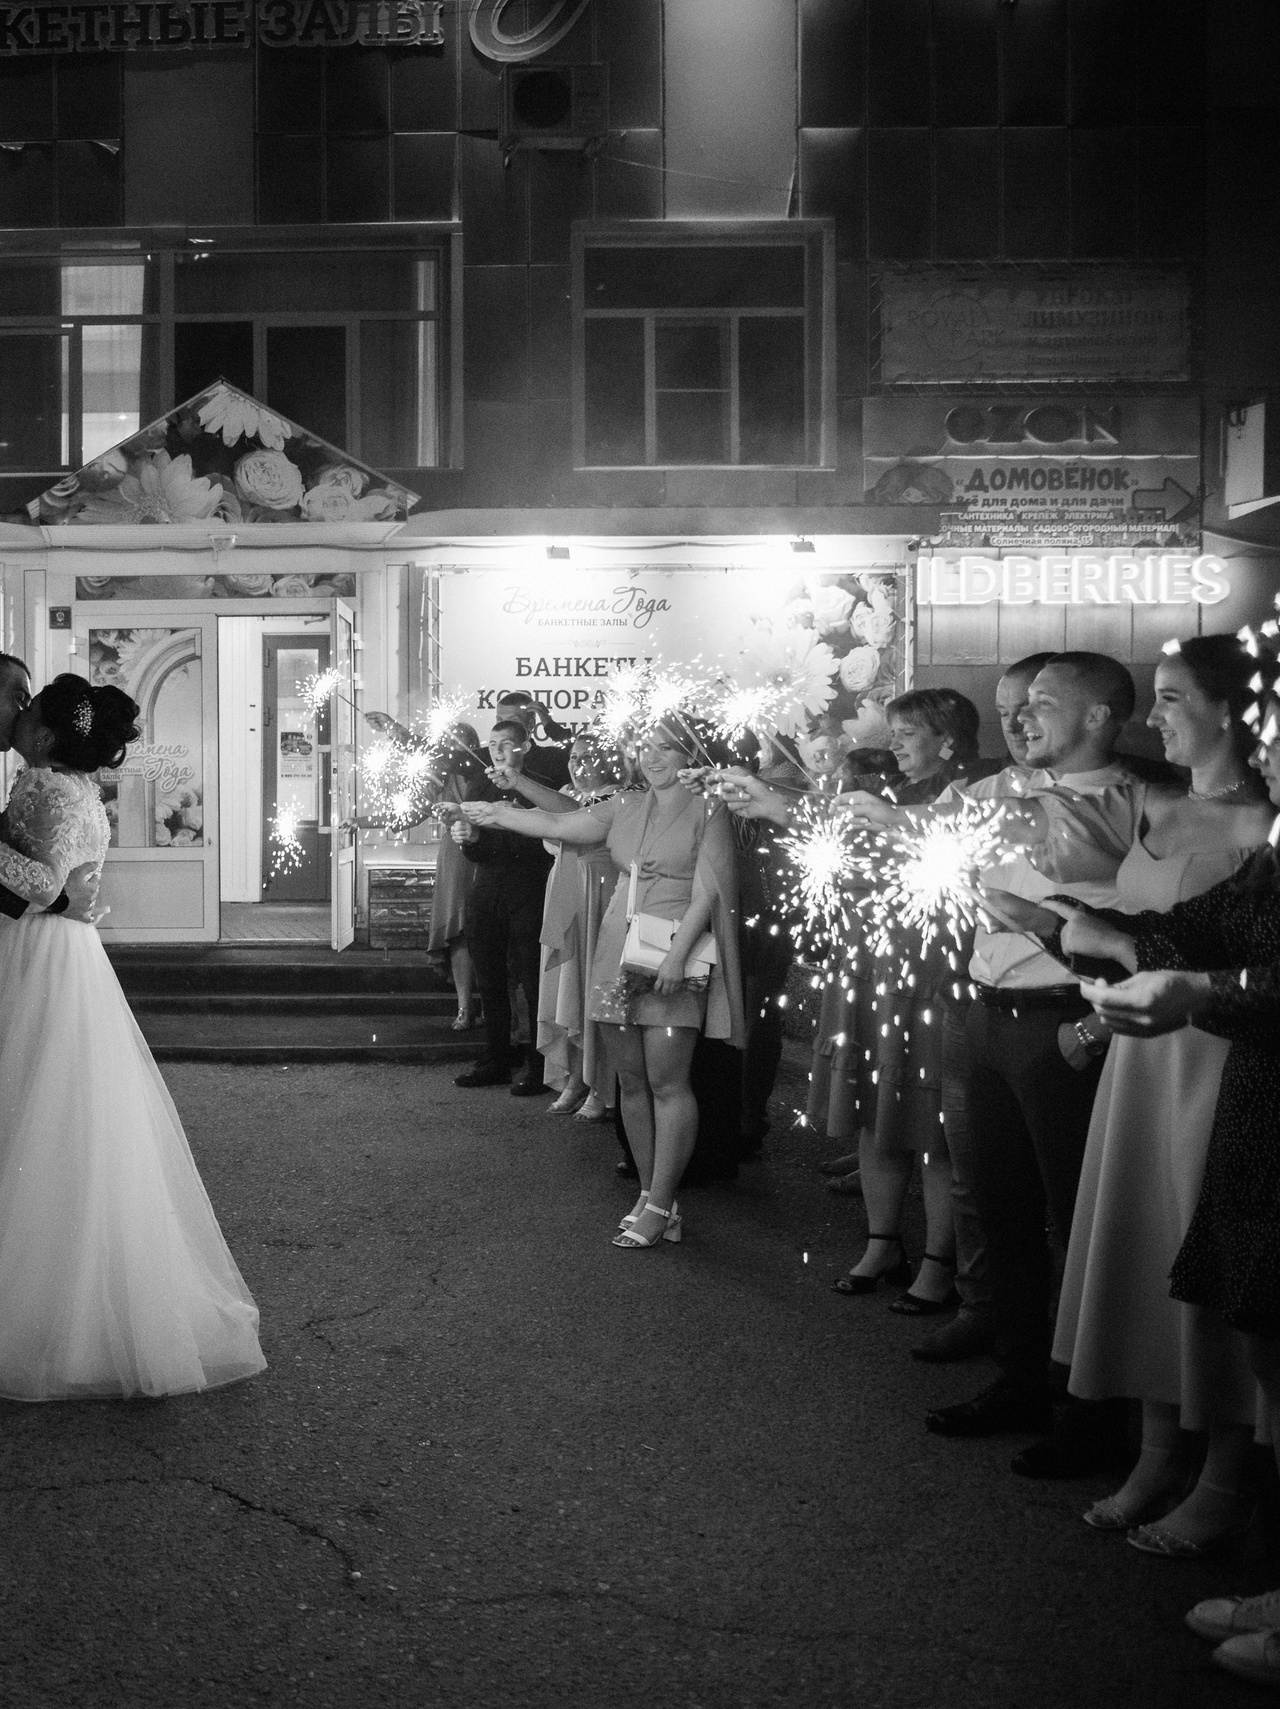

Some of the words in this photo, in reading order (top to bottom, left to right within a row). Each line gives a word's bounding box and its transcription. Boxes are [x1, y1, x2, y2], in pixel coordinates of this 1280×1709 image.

[262, 0, 444, 43] ЗАЛЫ
[946, 405, 1122, 444] OZON
[982, 497, 1008, 508] для
[1010, 497, 1047, 508] дома
[1050, 497, 1059, 506] и
[1061, 497, 1088, 508] для
[1090, 496, 1124, 507] дачи
[958, 512, 1014, 521] САНТЕХНИКА
[1064, 511, 1115, 520] ЭЛЕКТРИКА
[939, 524, 973, 533] ОЧНЫЕ
[974, 524, 1029, 534] МАТЕРИАЛЫ
[1033, 523, 1128, 534] САДОВО-ОГОРОДНЫЙ
[990, 537, 1040, 546] Солнечная
[610, 586, 672, 629] Года
[538, 618, 598, 627] БАНКЕТНЫЕ
[600, 618, 628, 627] ЗАЛЫ
[144, 757, 192, 791] Года
